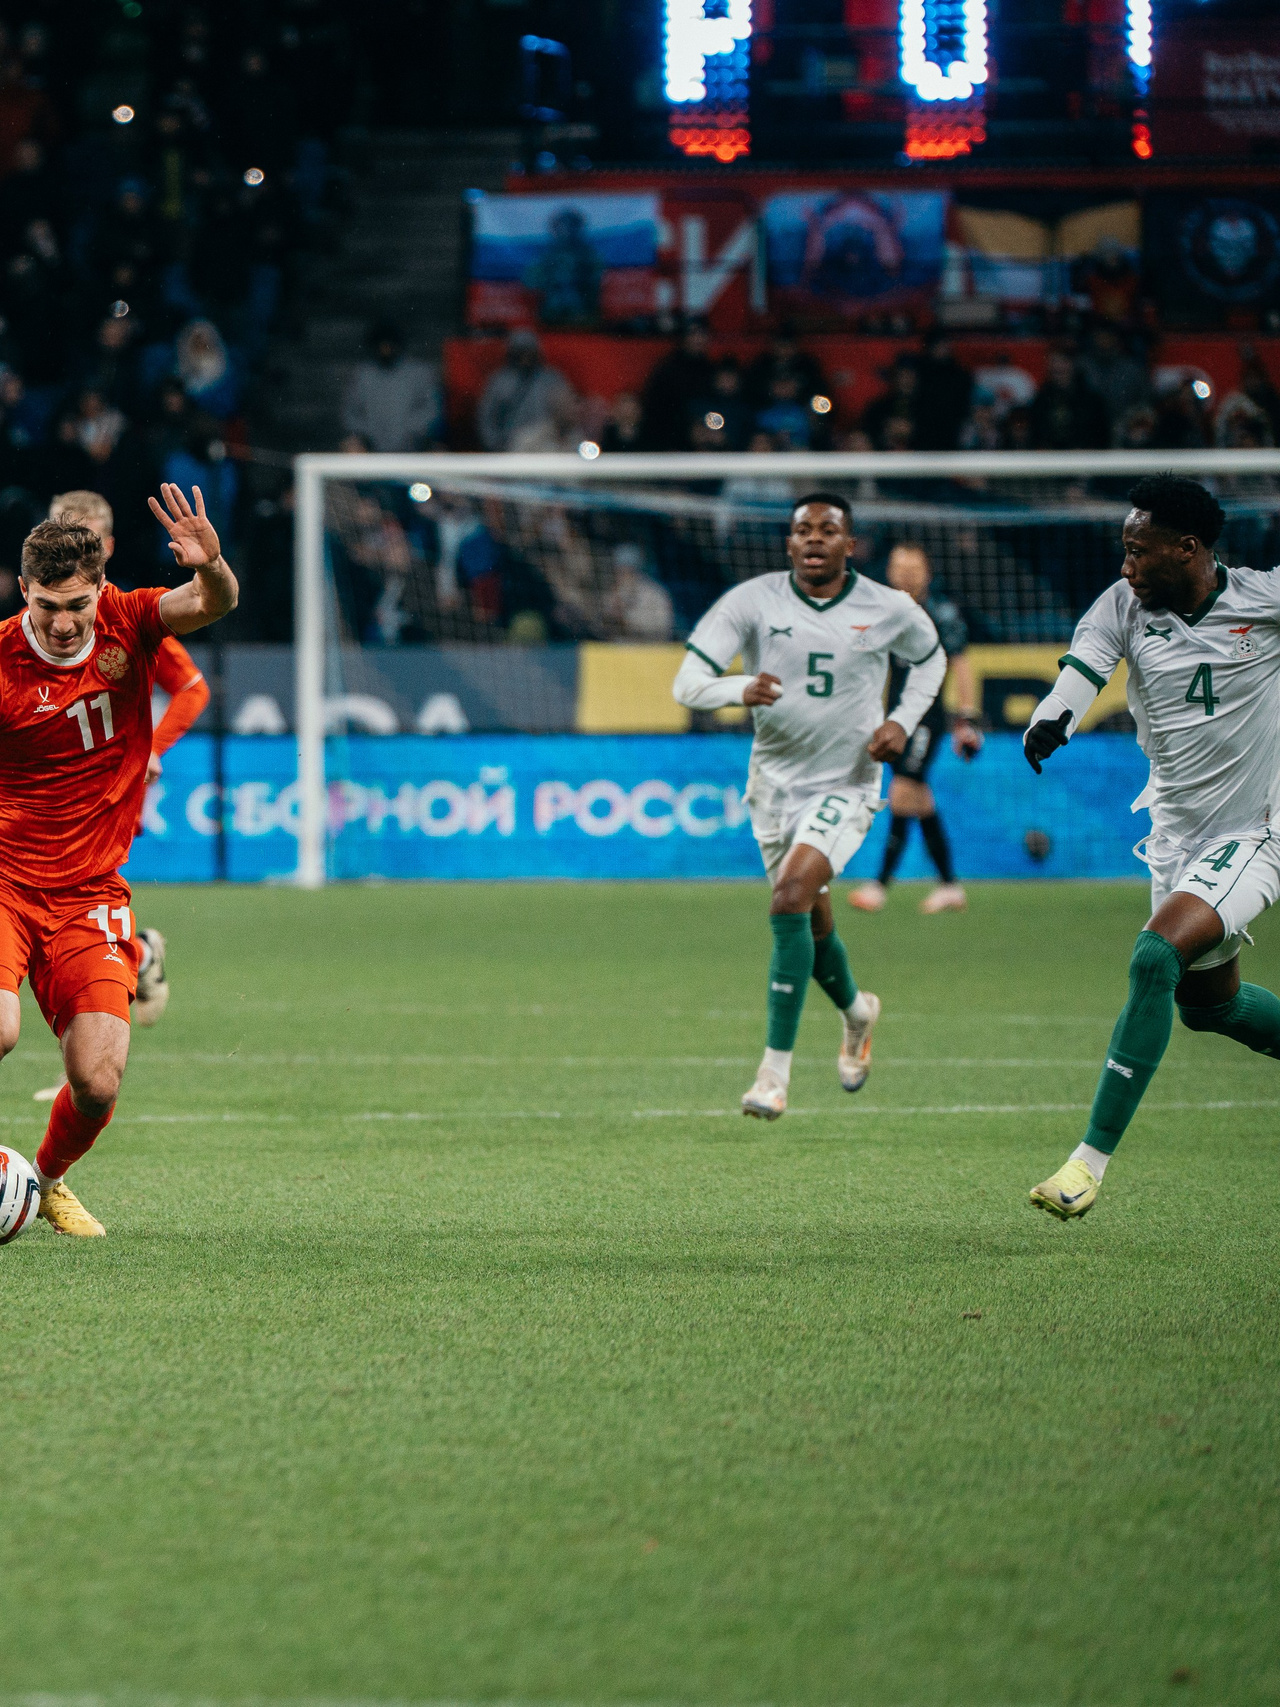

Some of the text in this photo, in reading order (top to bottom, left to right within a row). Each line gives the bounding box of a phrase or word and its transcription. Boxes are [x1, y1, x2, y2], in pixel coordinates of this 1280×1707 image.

[806, 652, 834, 697] 5
[1185, 662, 1220, 716] 4
[65, 691, 115, 752] 11
[816, 794, 849, 836] 5
[1200, 840, 1240, 873] 4
[87, 904, 131, 943] 11
